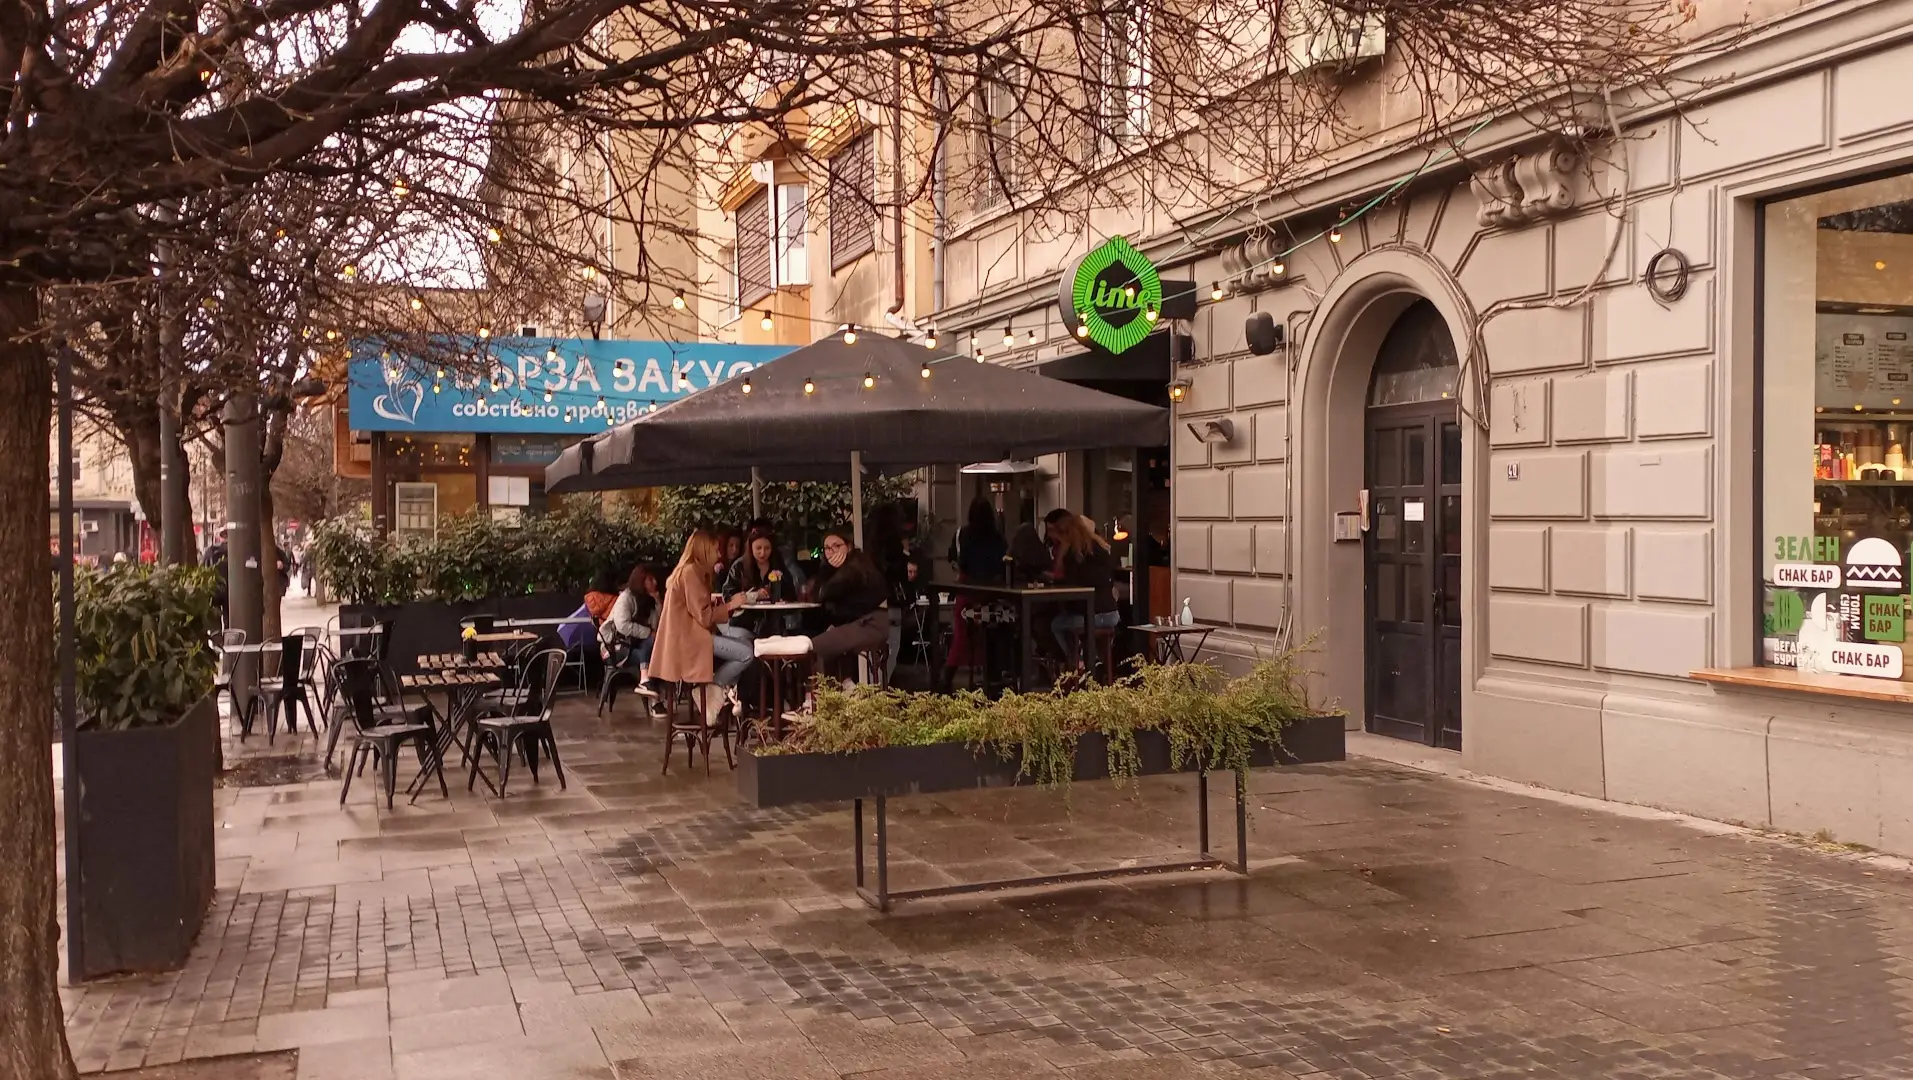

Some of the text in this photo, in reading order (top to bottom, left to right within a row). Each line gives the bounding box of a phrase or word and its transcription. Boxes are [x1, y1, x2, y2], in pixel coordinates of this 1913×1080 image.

[1084, 280, 1153, 309] lime
[613, 357, 763, 393] ЗАКУС
[1774, 536, 1840, 561] ЗЕЛЕН
[1779, 569, 1833, 583] СНАК БАР
[1840, 594, 1850, 621] СУПИ
[1850, 594, 1860, 630] ТОПЛИ
[1869, 602, 1900, 617] СНАК
[1869, 619, 1892, 633] БАР
[1832, 651, 1890, 668] СНАК БАР
